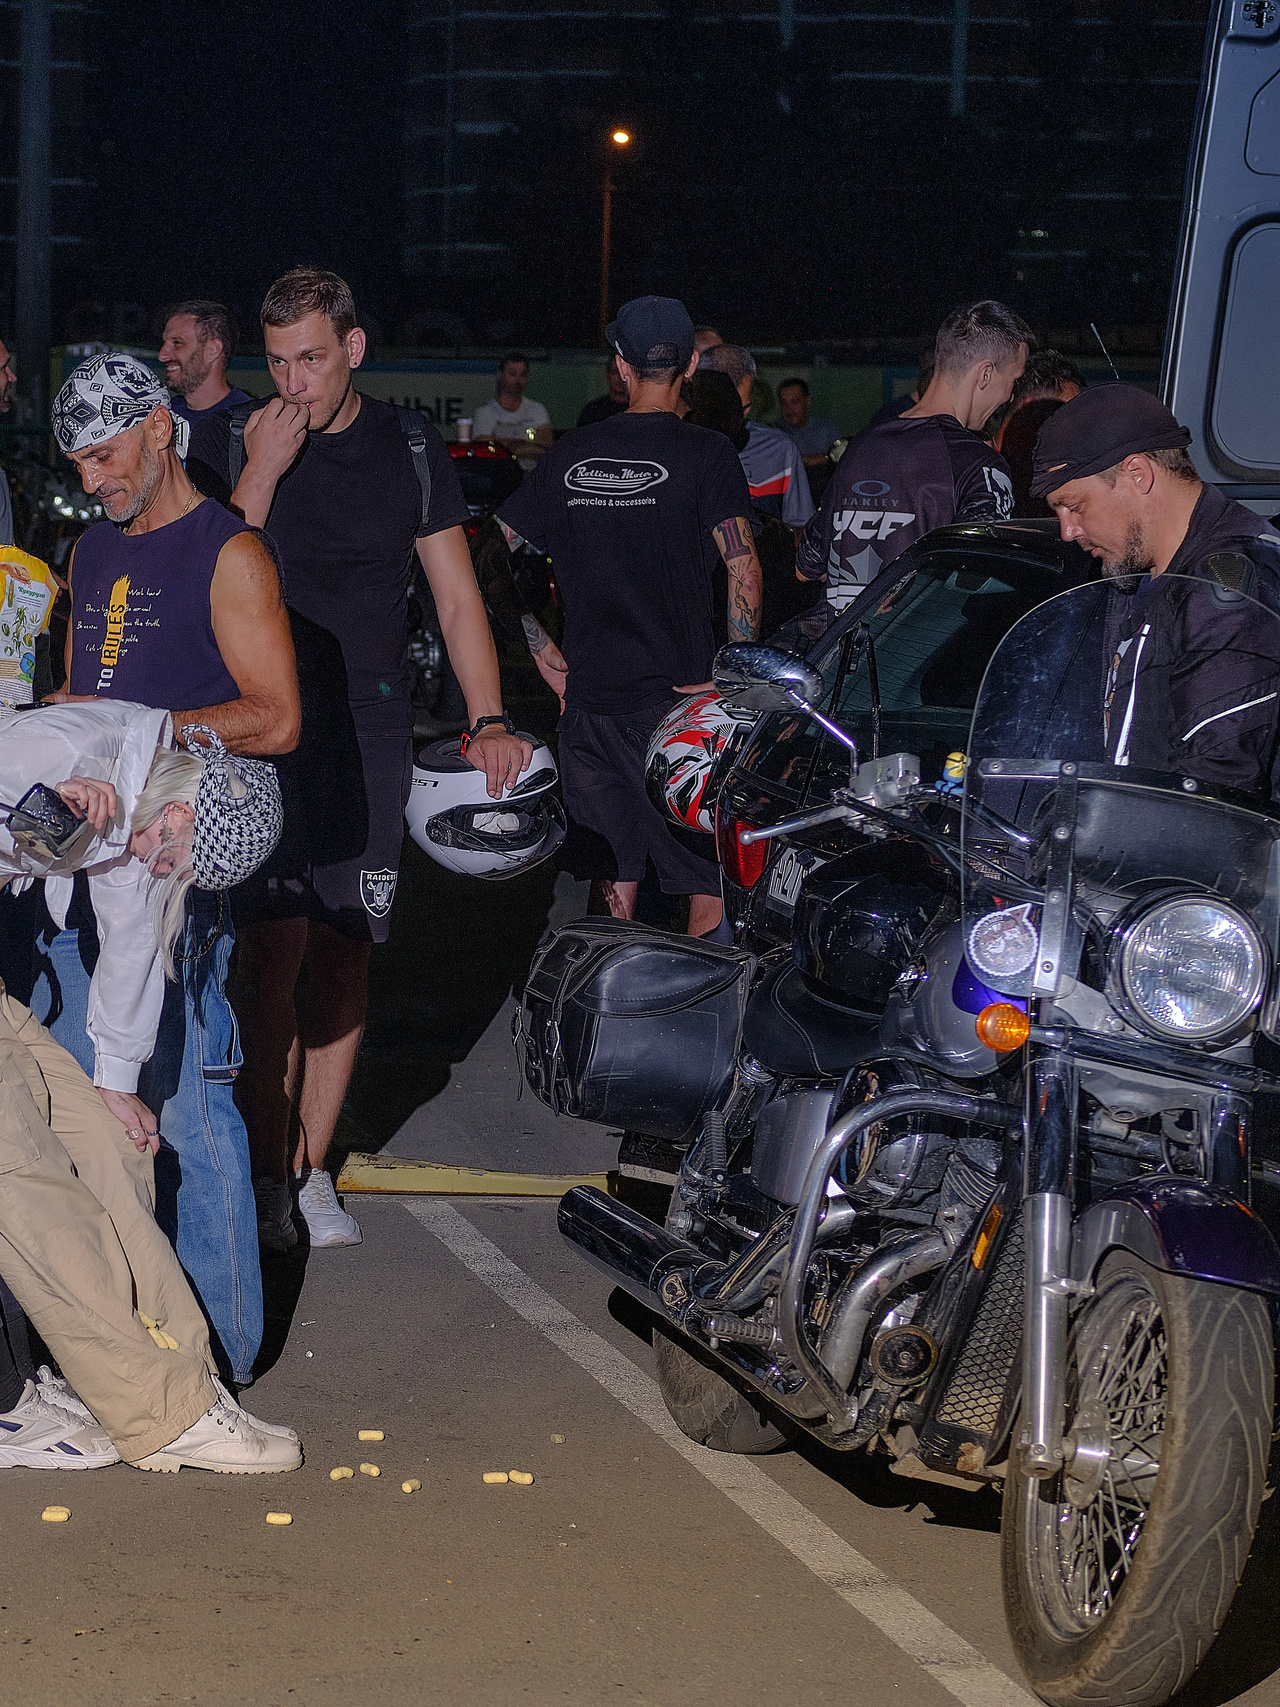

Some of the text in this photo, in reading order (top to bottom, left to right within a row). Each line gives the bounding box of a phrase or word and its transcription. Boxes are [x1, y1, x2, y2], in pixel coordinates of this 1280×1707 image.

[577, 466, 619, 480] Rolling
[833, 510, 916, 541] YCF
[103, 603, 125, 659] RULES
[97, 668, 114, 690] TO
